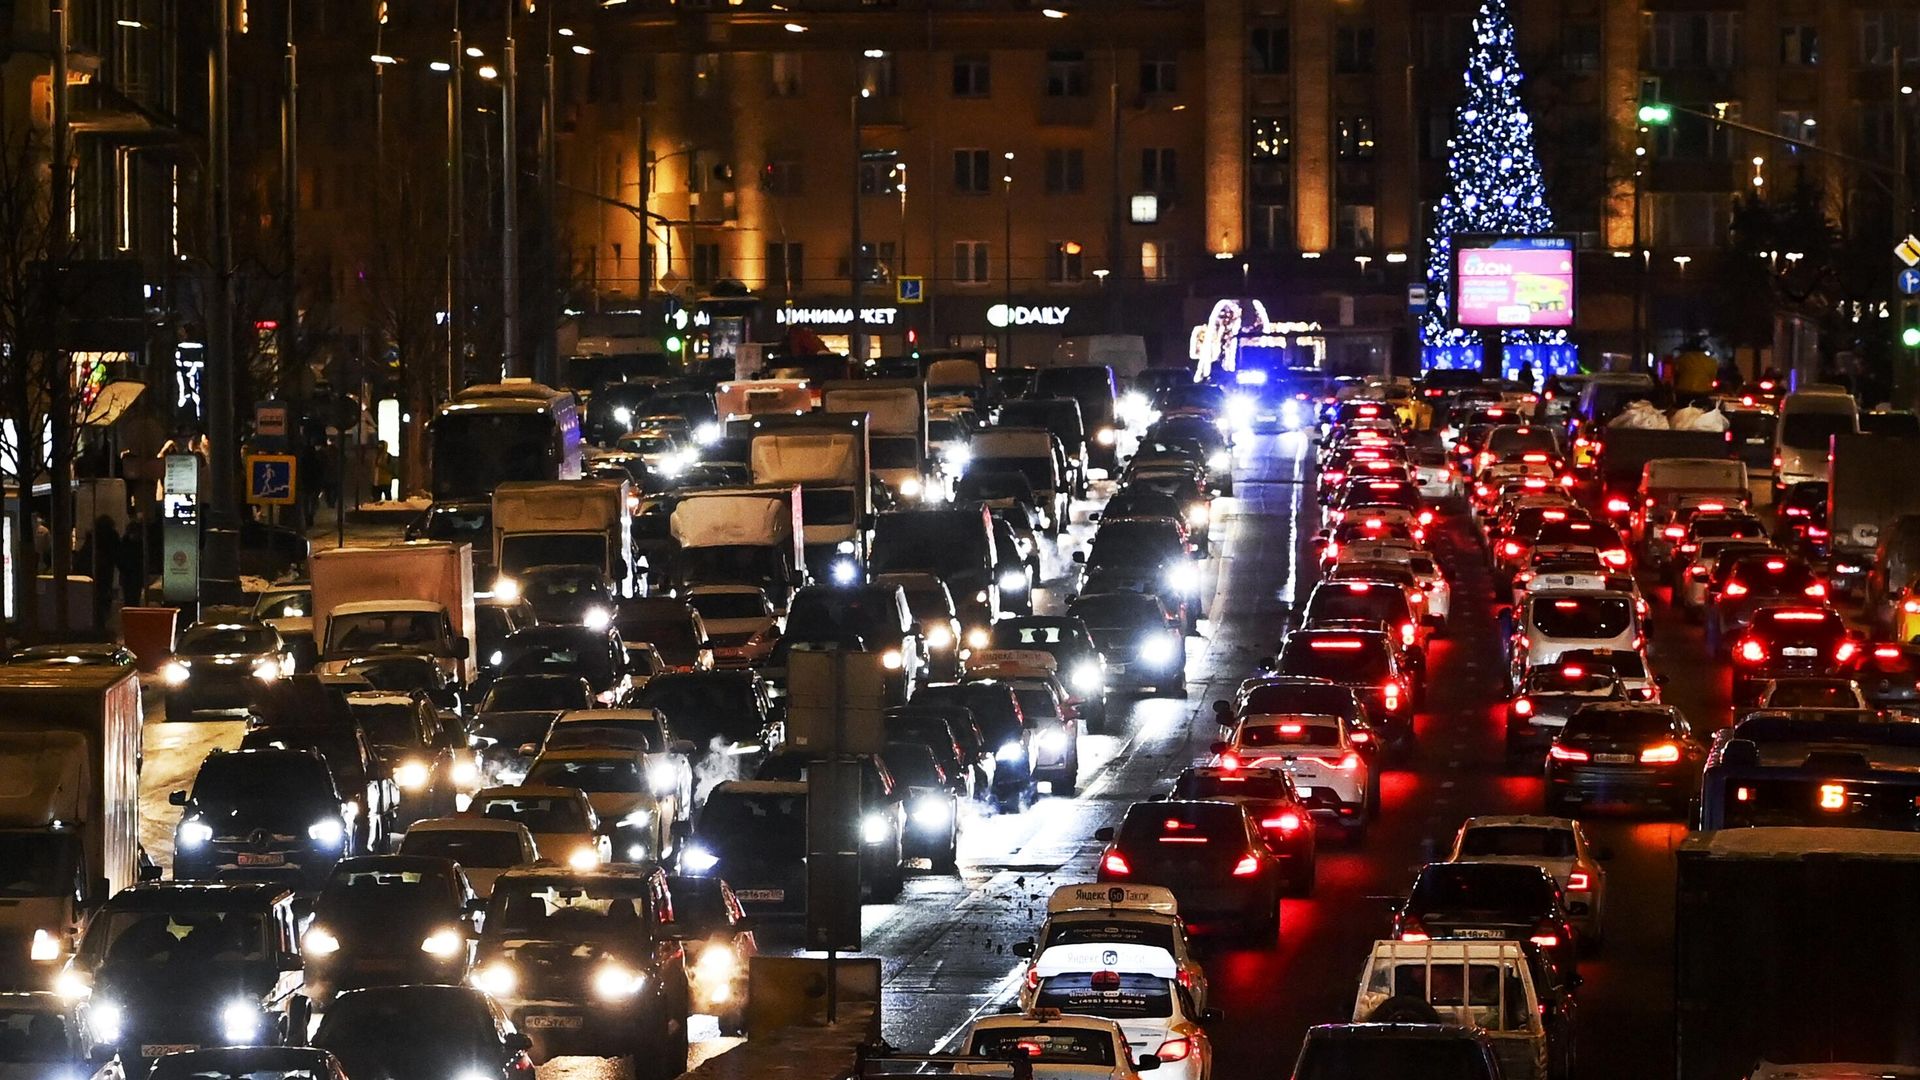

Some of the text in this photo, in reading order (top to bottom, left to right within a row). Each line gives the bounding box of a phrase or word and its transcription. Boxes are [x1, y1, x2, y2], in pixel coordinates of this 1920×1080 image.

[1075, 889, 1149, 901] Яндекс Go Такси
[1103, 951, 1118, 965] Go
